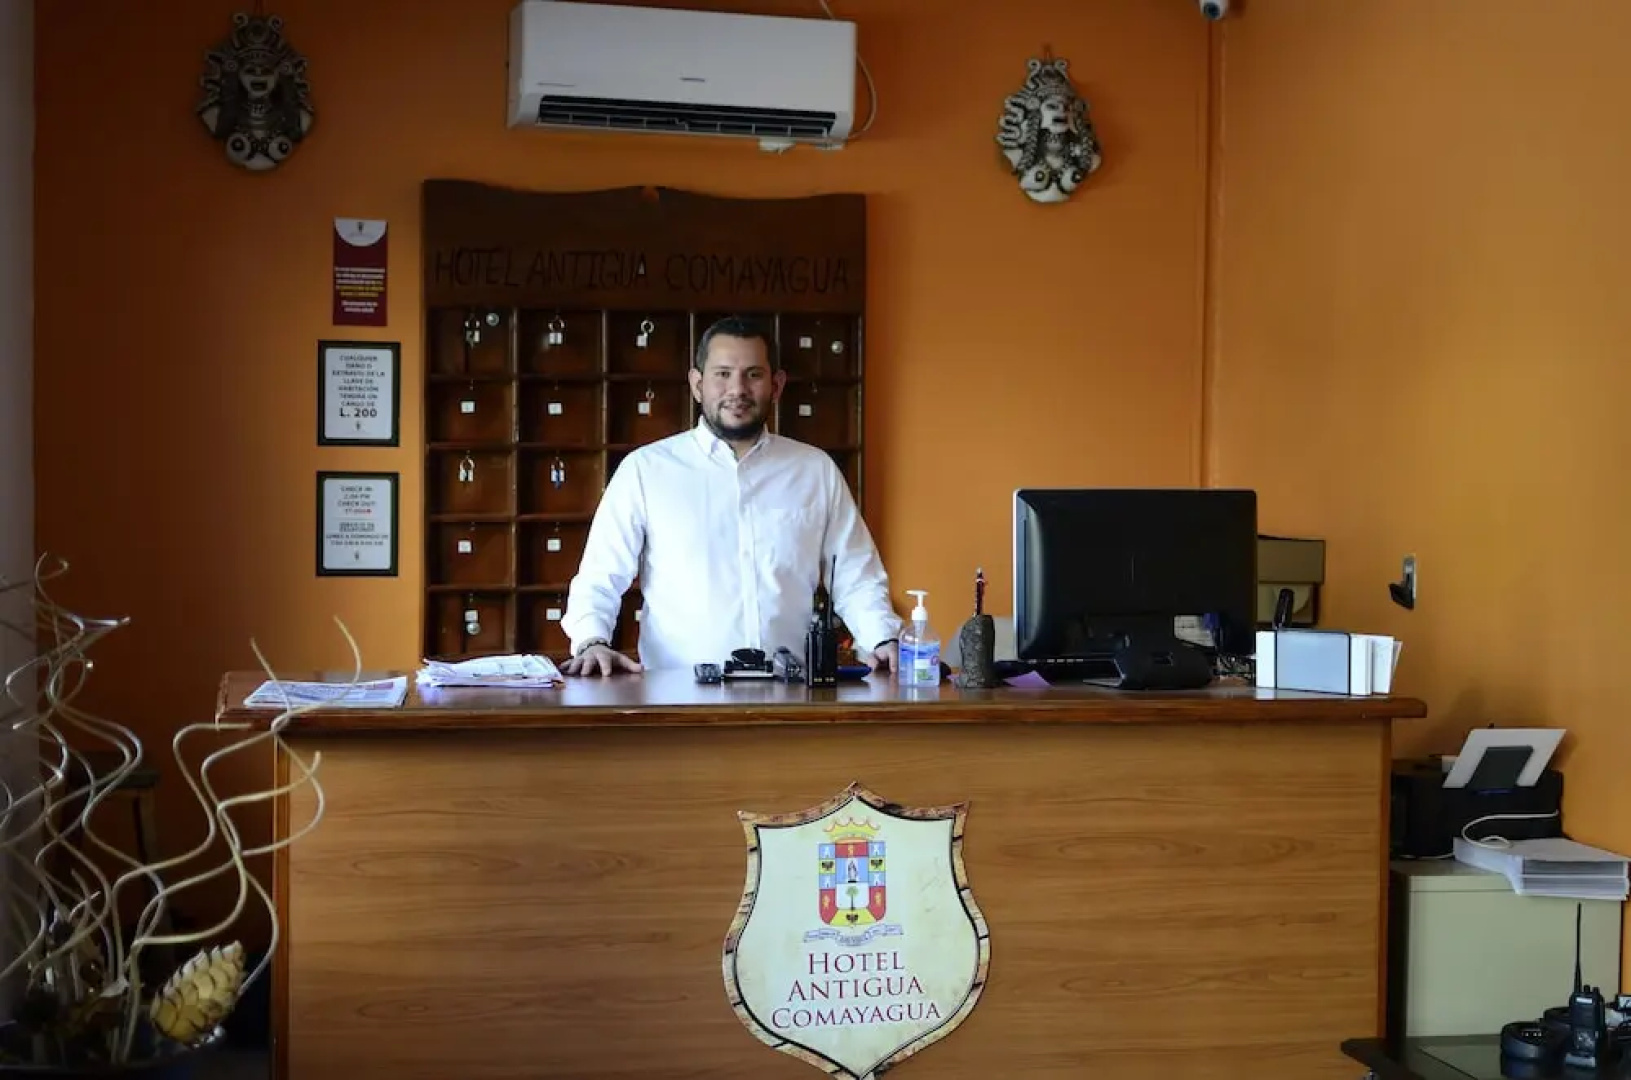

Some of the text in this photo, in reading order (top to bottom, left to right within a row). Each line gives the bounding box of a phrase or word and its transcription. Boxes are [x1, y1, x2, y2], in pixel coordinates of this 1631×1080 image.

[435, 247, 849, 295] HOTEL ANTIGUA COMAYAGUA
[339, 408, 378, 418] L. 200
[808, 951, 906, 975] HOTEL
[788, 976, 925, 1002] ANTIGUA
[771, 1002, 941, 1029] COMAYAGUA
